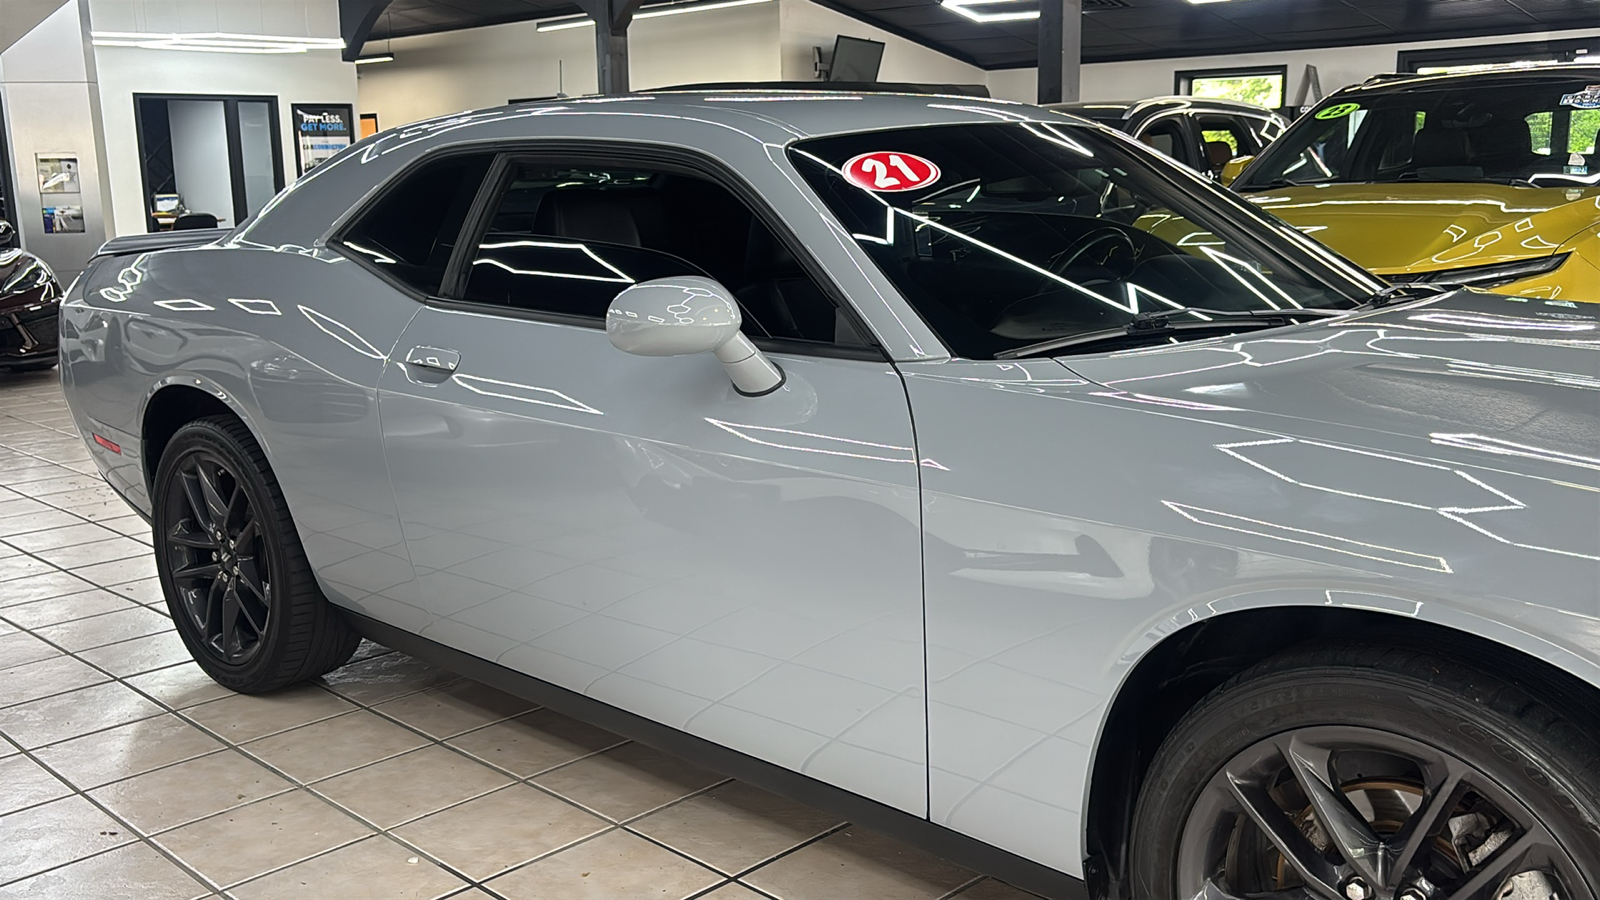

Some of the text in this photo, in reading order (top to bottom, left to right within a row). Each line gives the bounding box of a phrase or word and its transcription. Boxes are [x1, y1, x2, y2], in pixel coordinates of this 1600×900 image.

[321, 114, 343, 123] LESS.
[300, 123, 347, 131] GET MORE.
[861, 154, 921, 188] 21
